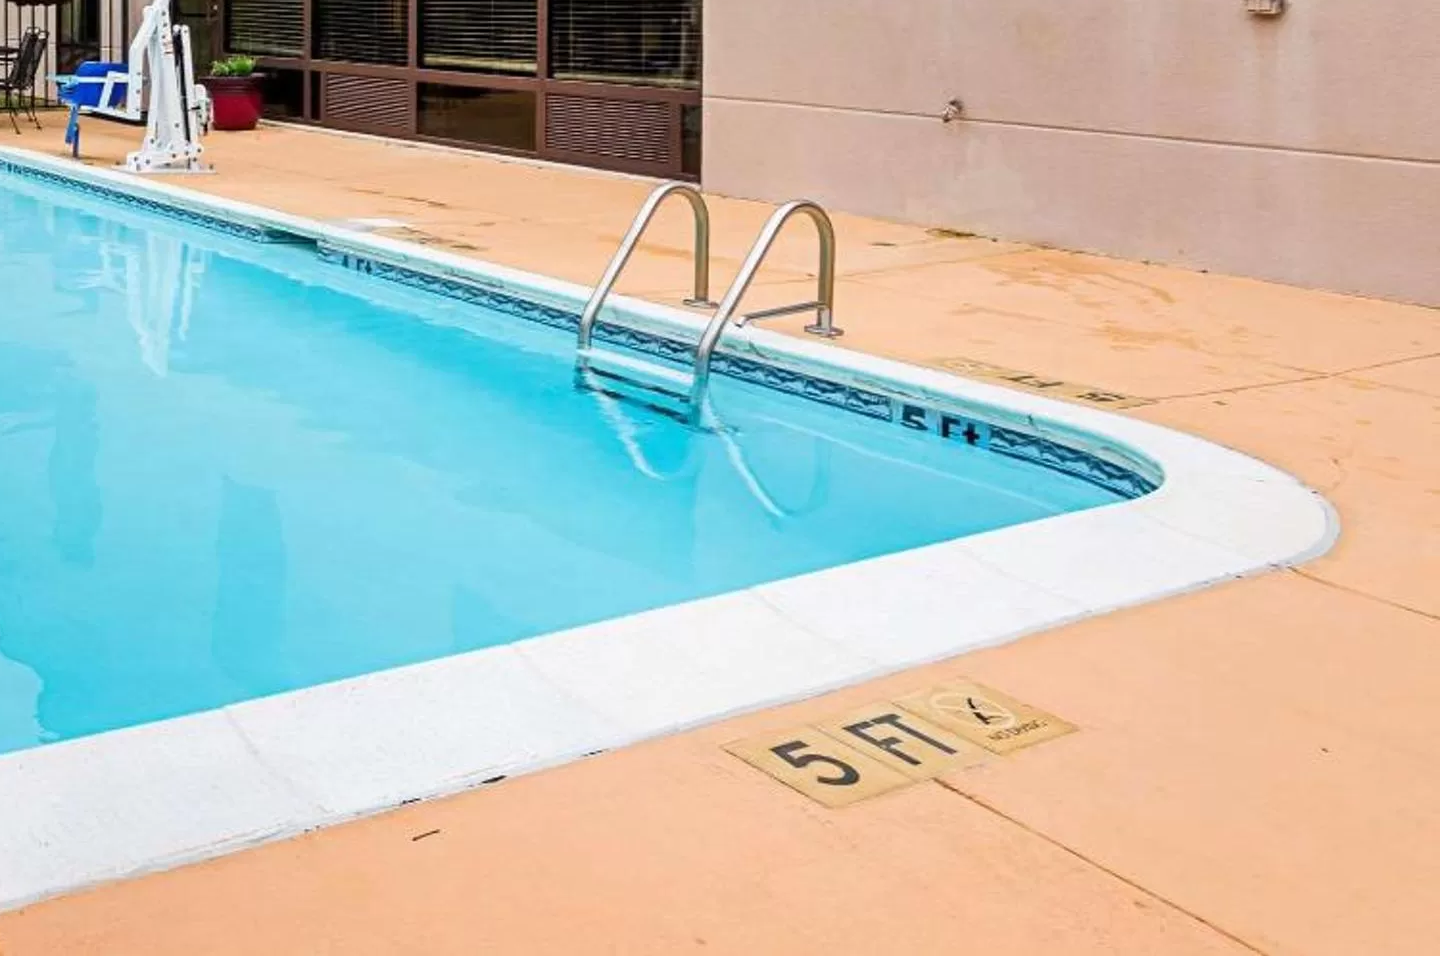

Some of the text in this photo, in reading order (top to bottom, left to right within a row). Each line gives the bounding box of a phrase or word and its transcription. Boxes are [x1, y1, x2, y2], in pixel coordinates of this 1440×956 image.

[901, 403, 928, 431] 5
[769, 713, 958, 786] 5 FT
